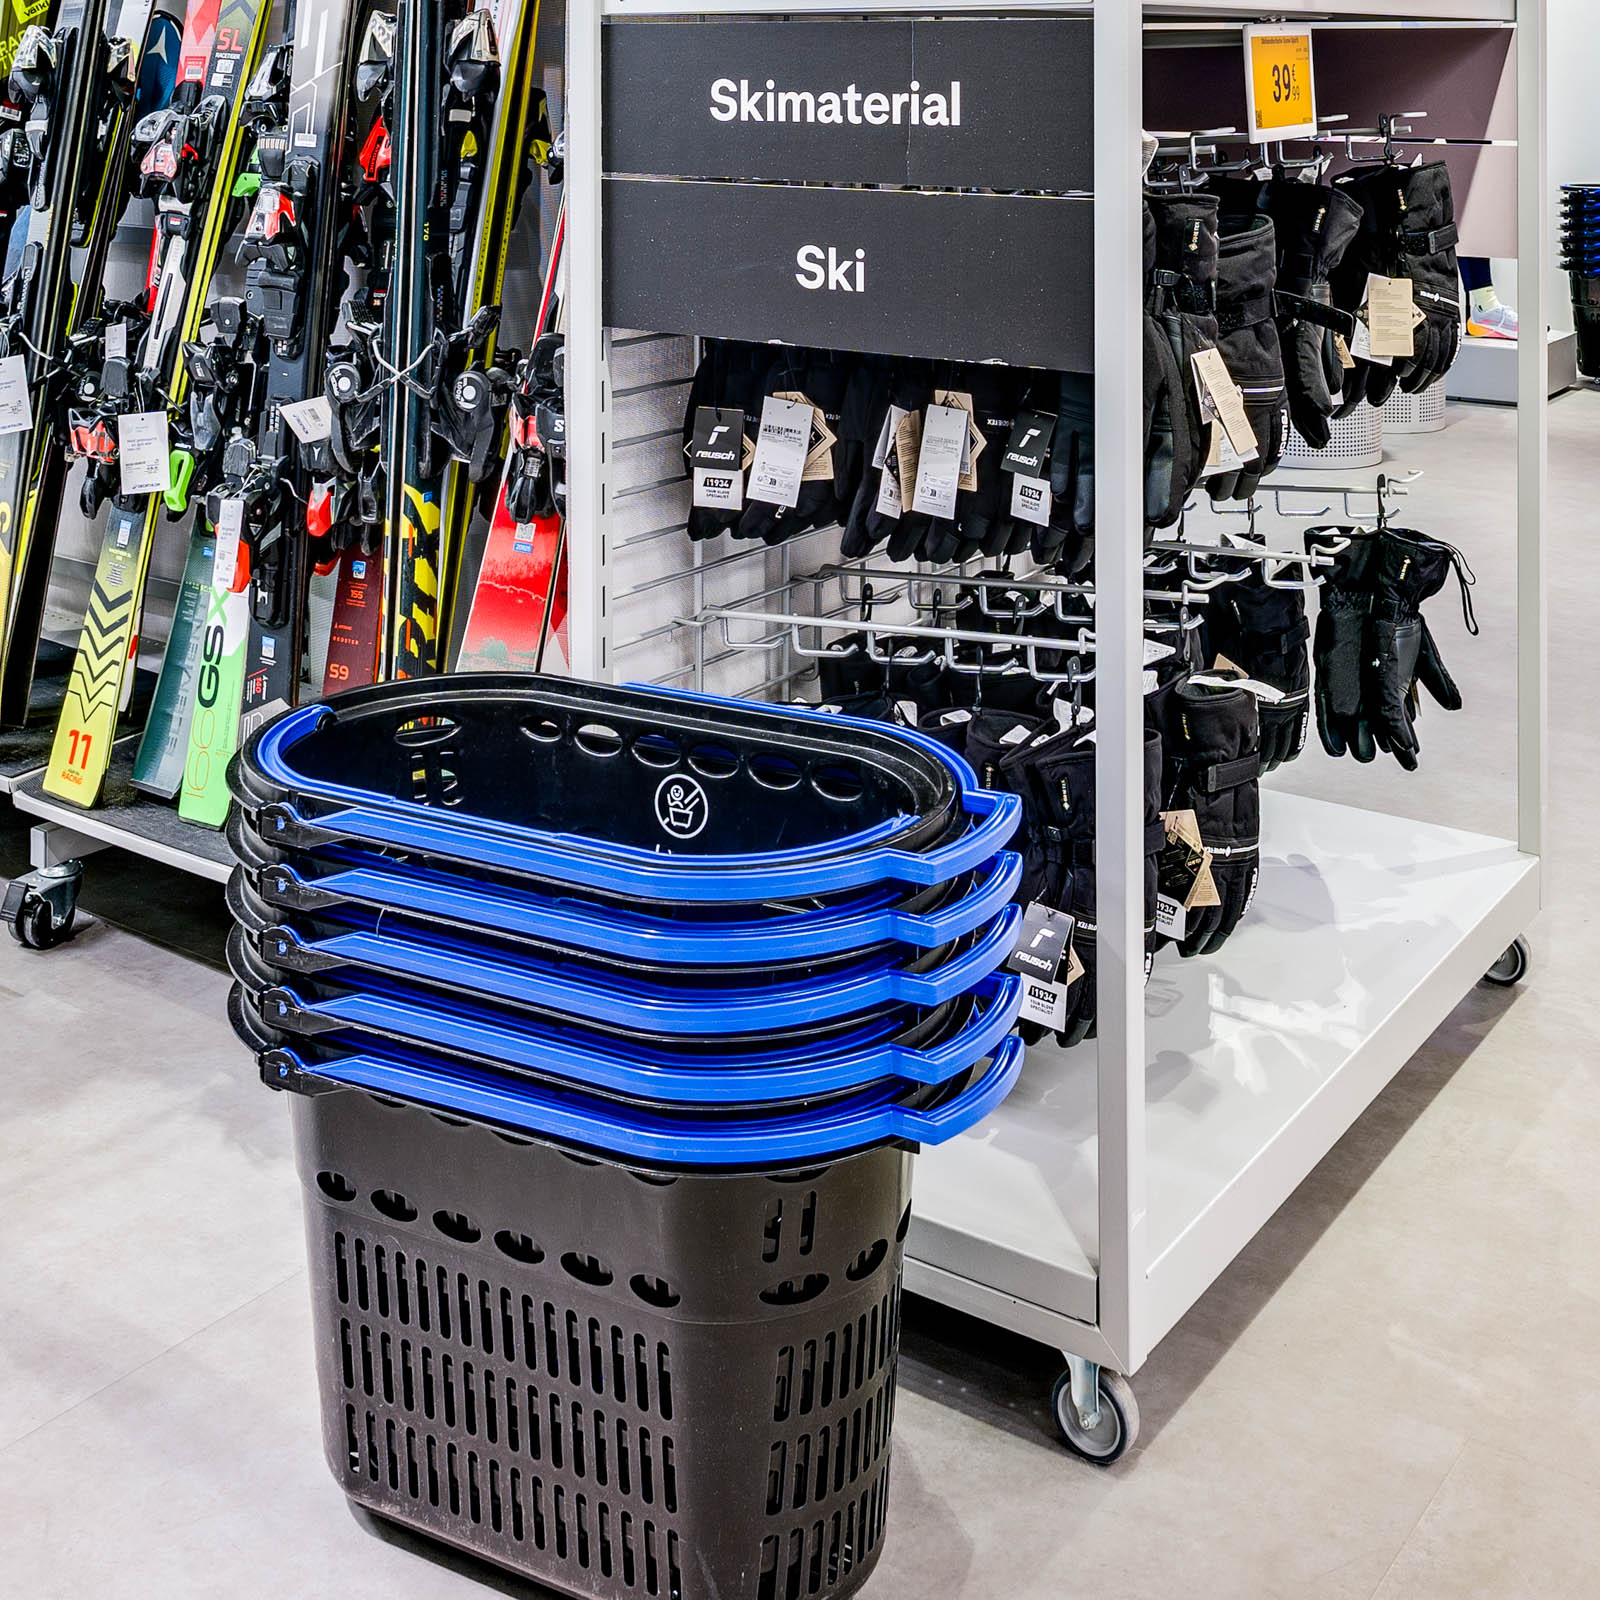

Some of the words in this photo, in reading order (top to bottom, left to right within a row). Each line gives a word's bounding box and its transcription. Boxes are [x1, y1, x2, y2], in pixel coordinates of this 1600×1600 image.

[24, 0, 49, 17] Völkl
[217, 27, 243, 52] SL
[1272, 64, 1290, 103] 39
[710, 79, 961, 127] Skimaterial
[795, 244, 865, 292] Ski
[1278, 408, 1289, 457] reusch
[696, 450, 735, 461] reusch
[1006, 452, 1039, 467] reusch
[332, 635, 360, 646] REDSTER
[1297, 711, 1308, 750] reusch
[68, 729, 92, 770] 11
[1157, 902, 1175, 915] 1934
[1014, 951, 1053, 972] reusch
[1030, 1004, 1054, 1016] SPECIALIST
